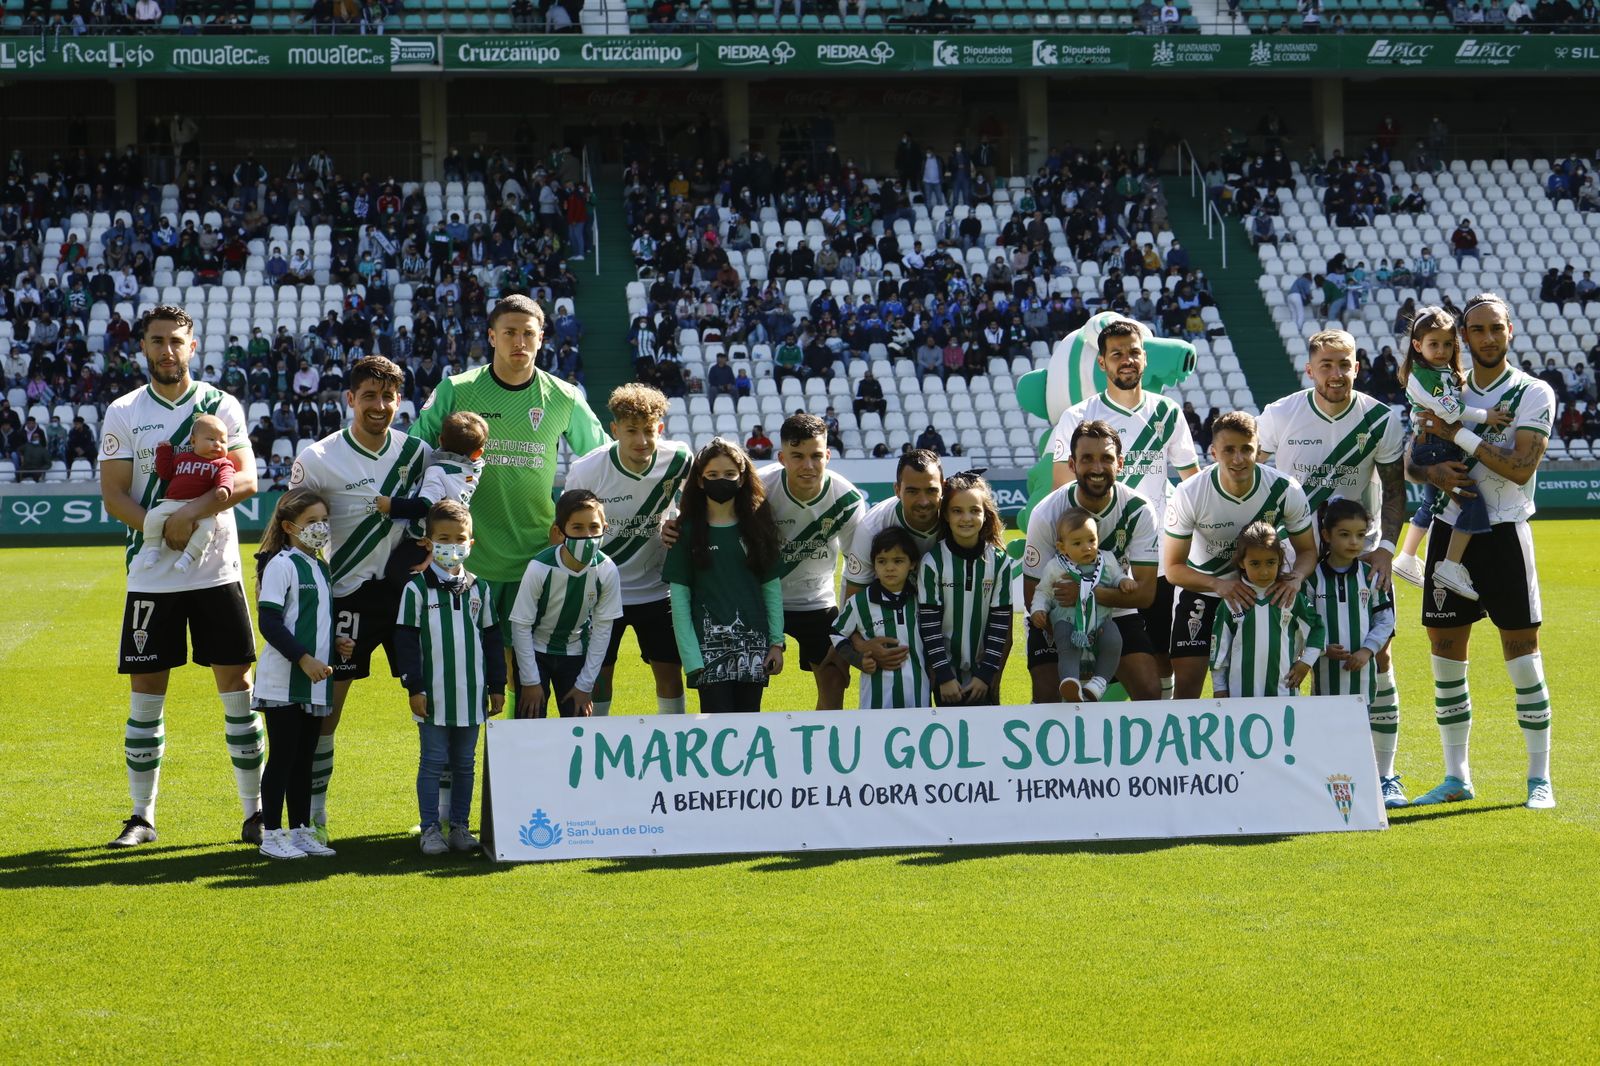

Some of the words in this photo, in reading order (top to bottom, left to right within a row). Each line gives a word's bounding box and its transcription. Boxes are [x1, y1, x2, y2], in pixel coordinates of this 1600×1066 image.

[458, 43, 560, 64] Cruzcampo
[581, 42, 682, 63] Cruzcampo
[1388, 45, 1434, 57] PACC
[1477, 45, 1521, 57] PACC
[519, 442, 546, 454] MESA
[1141, 450, 1164, 461] MESA
[175, 462, 219, 479] HAPPY
[1538, 480, 1588, 490] CENTRO
[132, 600, 155, 630] 17
[336, 610, 360, 640] 21
[568, 725, 778, 789] ¡MARCA
[790, 724, 861, 775] TU
[884, 719, 986, 770] GOL
[1002, 705, 1296, 770] SOLIDARIO!
[651, 791, 667, 814] A
[674, 788, 782, 812] BENEFICIO
[792, 786, 820, 808] DE
[826, 785, 852, 808] LA
[859, 783, 918, 806] OBRA
[925, 780, 1001, 804] SOCIAL
[566, 820, 596, 828] Hospital
[567, 828, 589, 837] San
[592, 827, 620, 837] Juan
[622, 826, 636, 835] de
[638, 824, 664, 834] Dios
